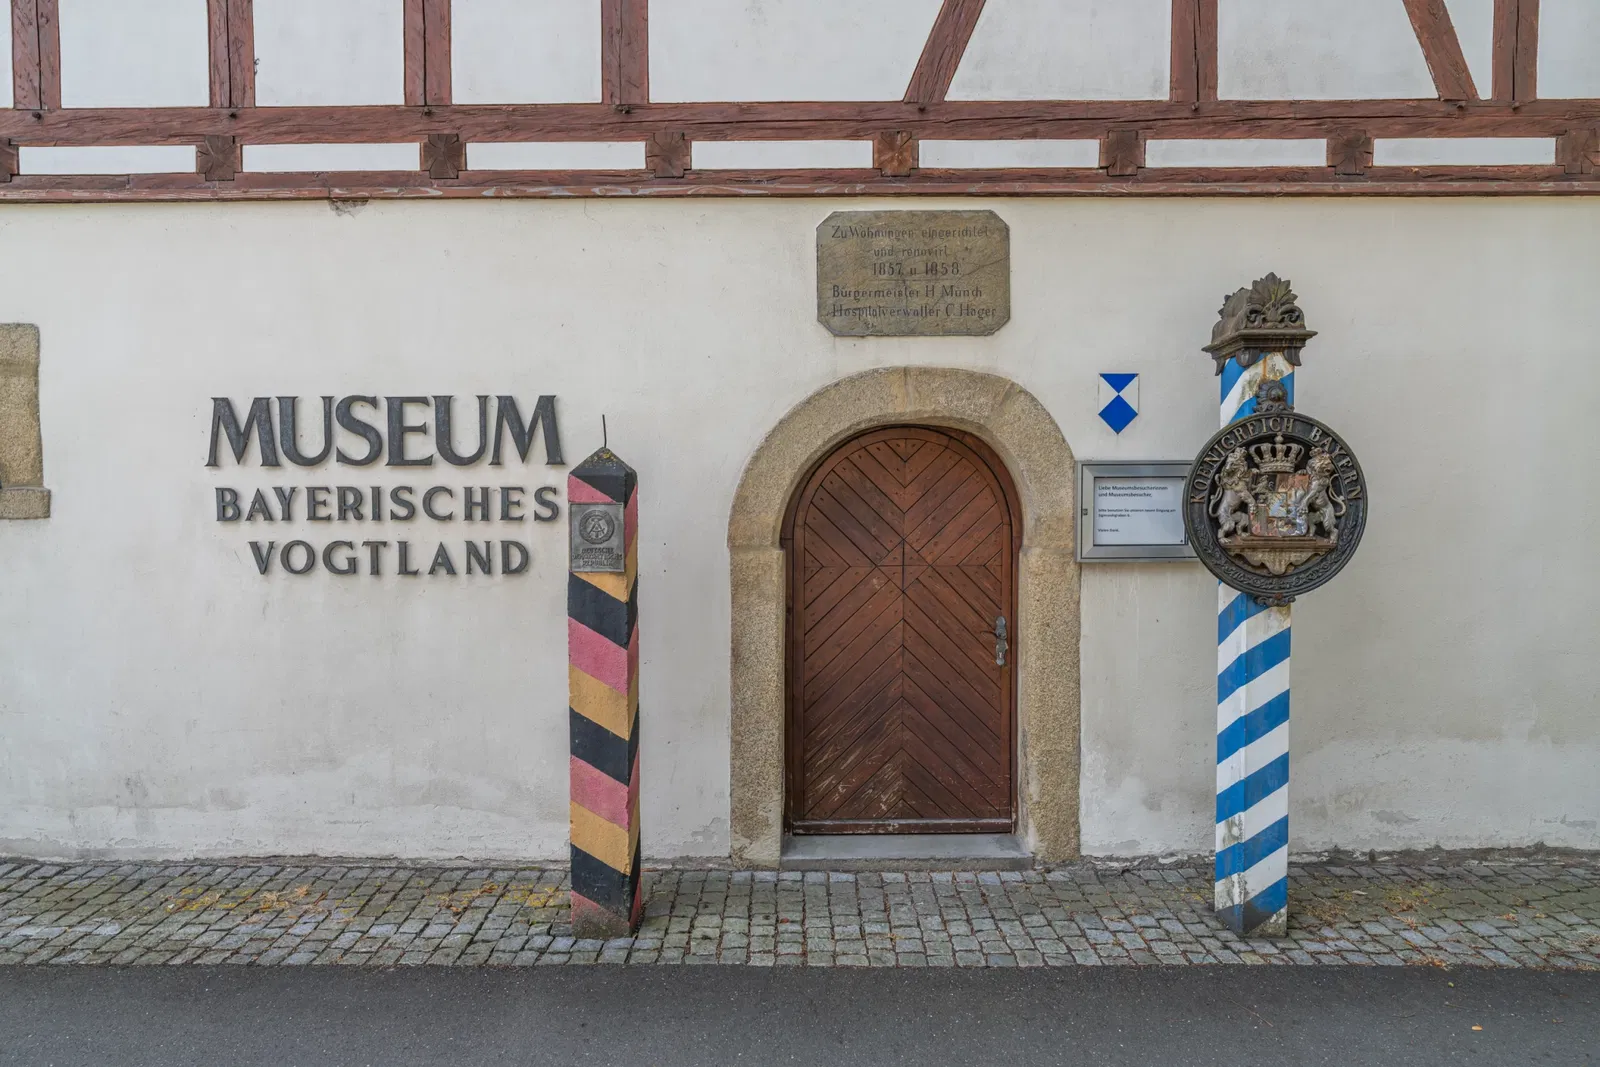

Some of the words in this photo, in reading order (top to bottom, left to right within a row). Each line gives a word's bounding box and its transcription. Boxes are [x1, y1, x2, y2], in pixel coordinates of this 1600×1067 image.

[873, 246, 894, 257] und
[205, 394, 568, 468] MUSEUM
[1190, 417, 1295, 504] KOENIGREICH
[1308, 425, 1363, 501] BAYERN
[215, 486, 560, 523] BAYERISCHES
[248, 539, 530, 576] VOGTLAND
